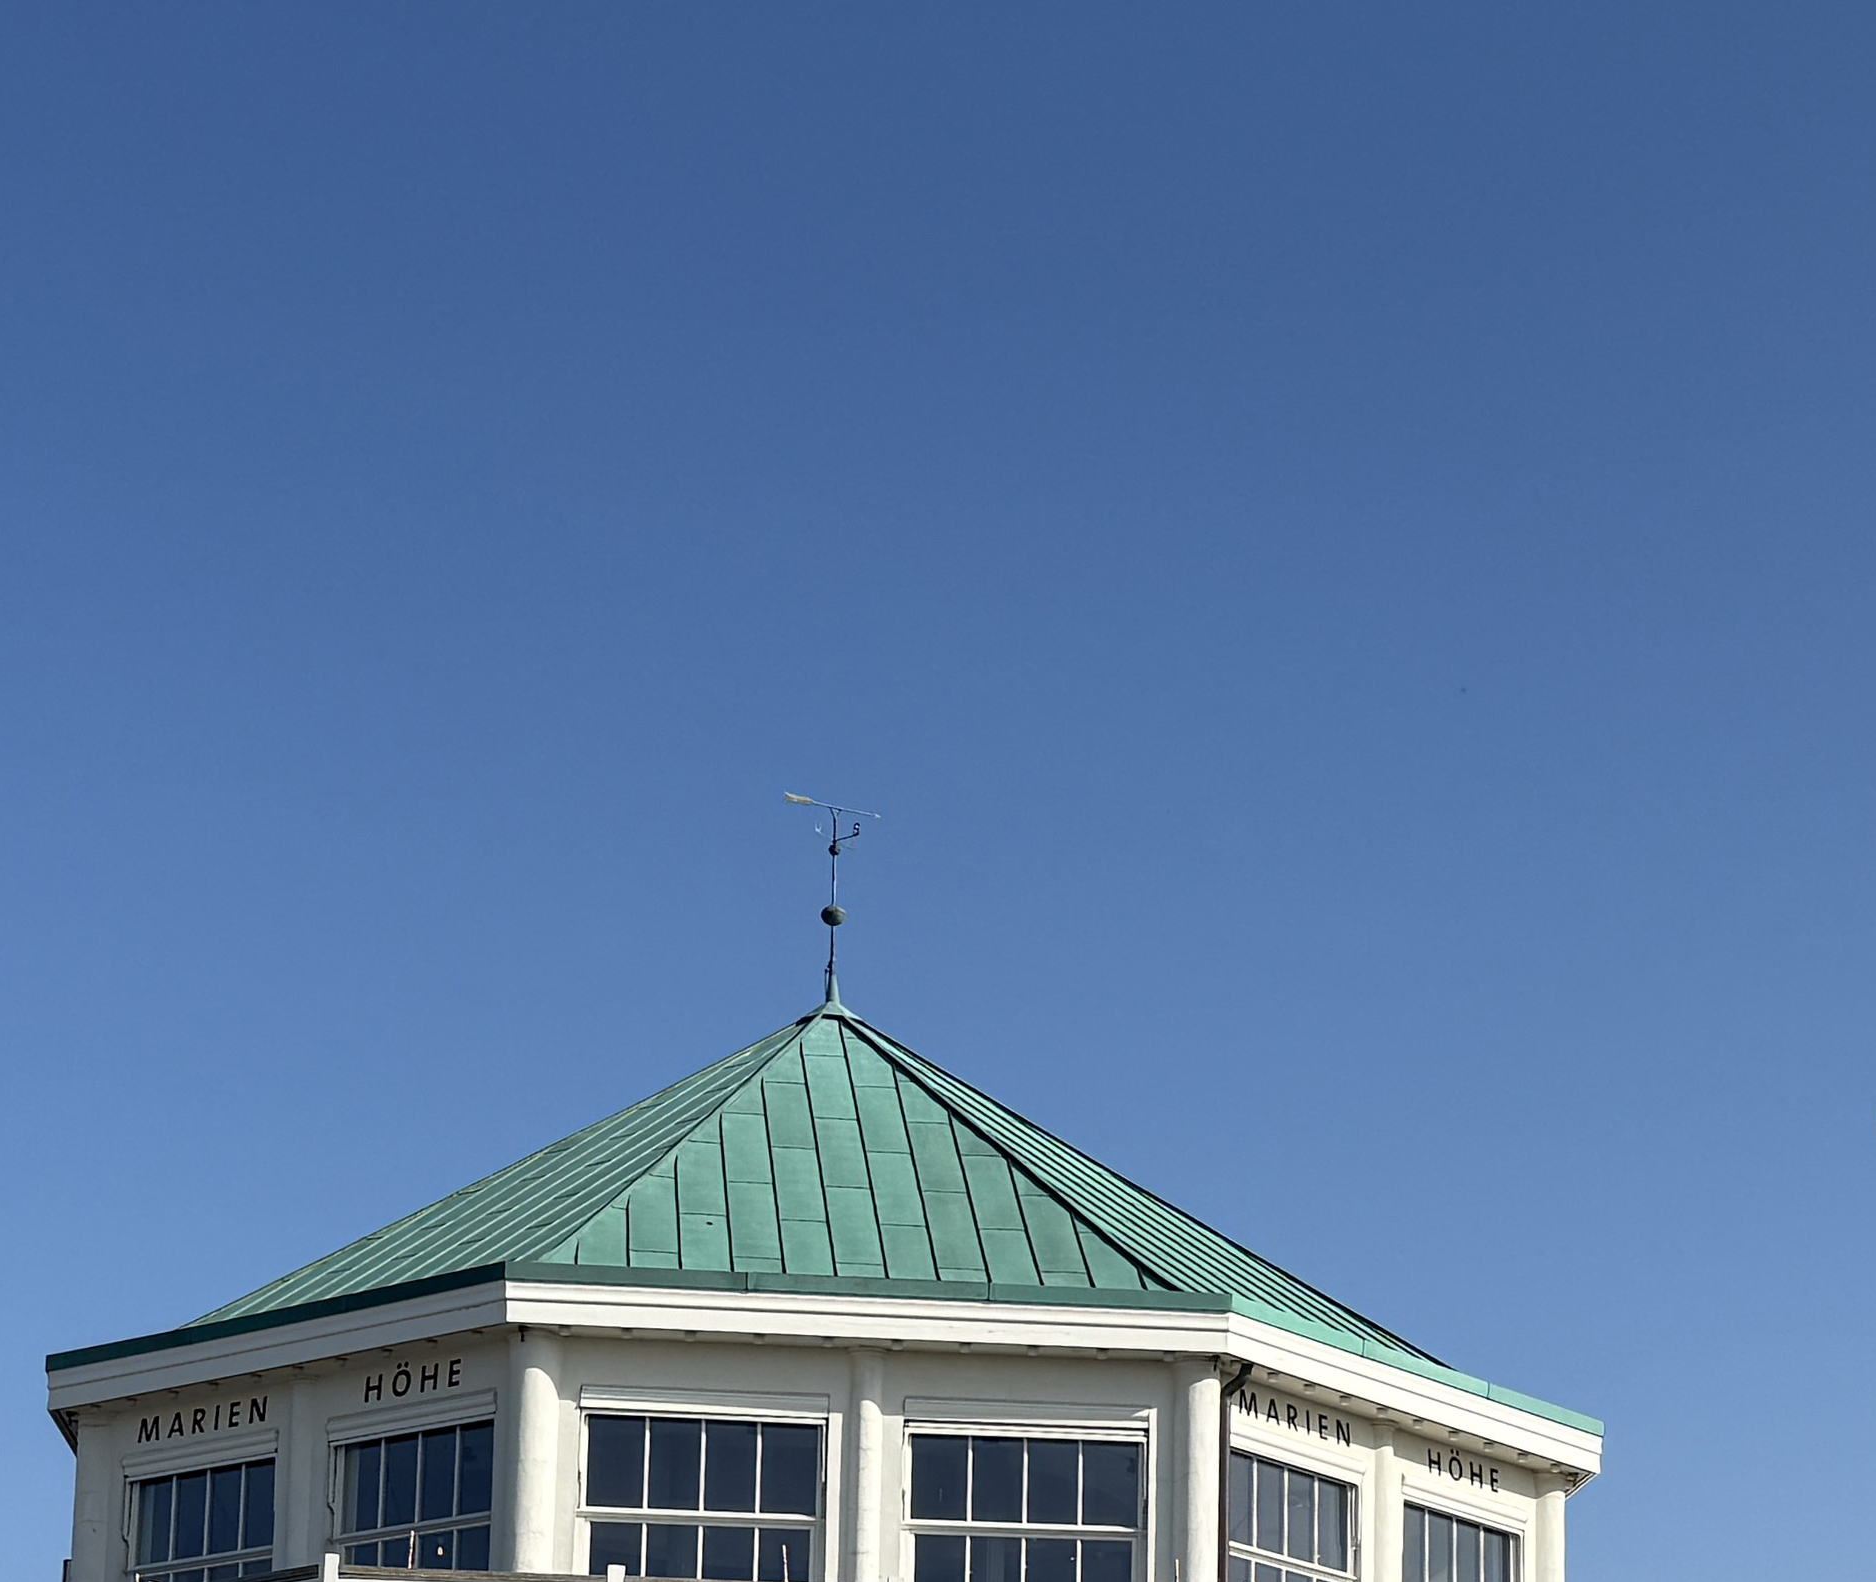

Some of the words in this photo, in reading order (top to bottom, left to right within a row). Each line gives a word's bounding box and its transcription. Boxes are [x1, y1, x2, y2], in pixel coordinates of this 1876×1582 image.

[137, 1395, 269, 1444] MARIEN
[363, 1358, 462, 1403] HÖHE
[1238, 1389, 1351, 1448] MARIEN
[1427, 1448, 1500, 1493] HÖHE
